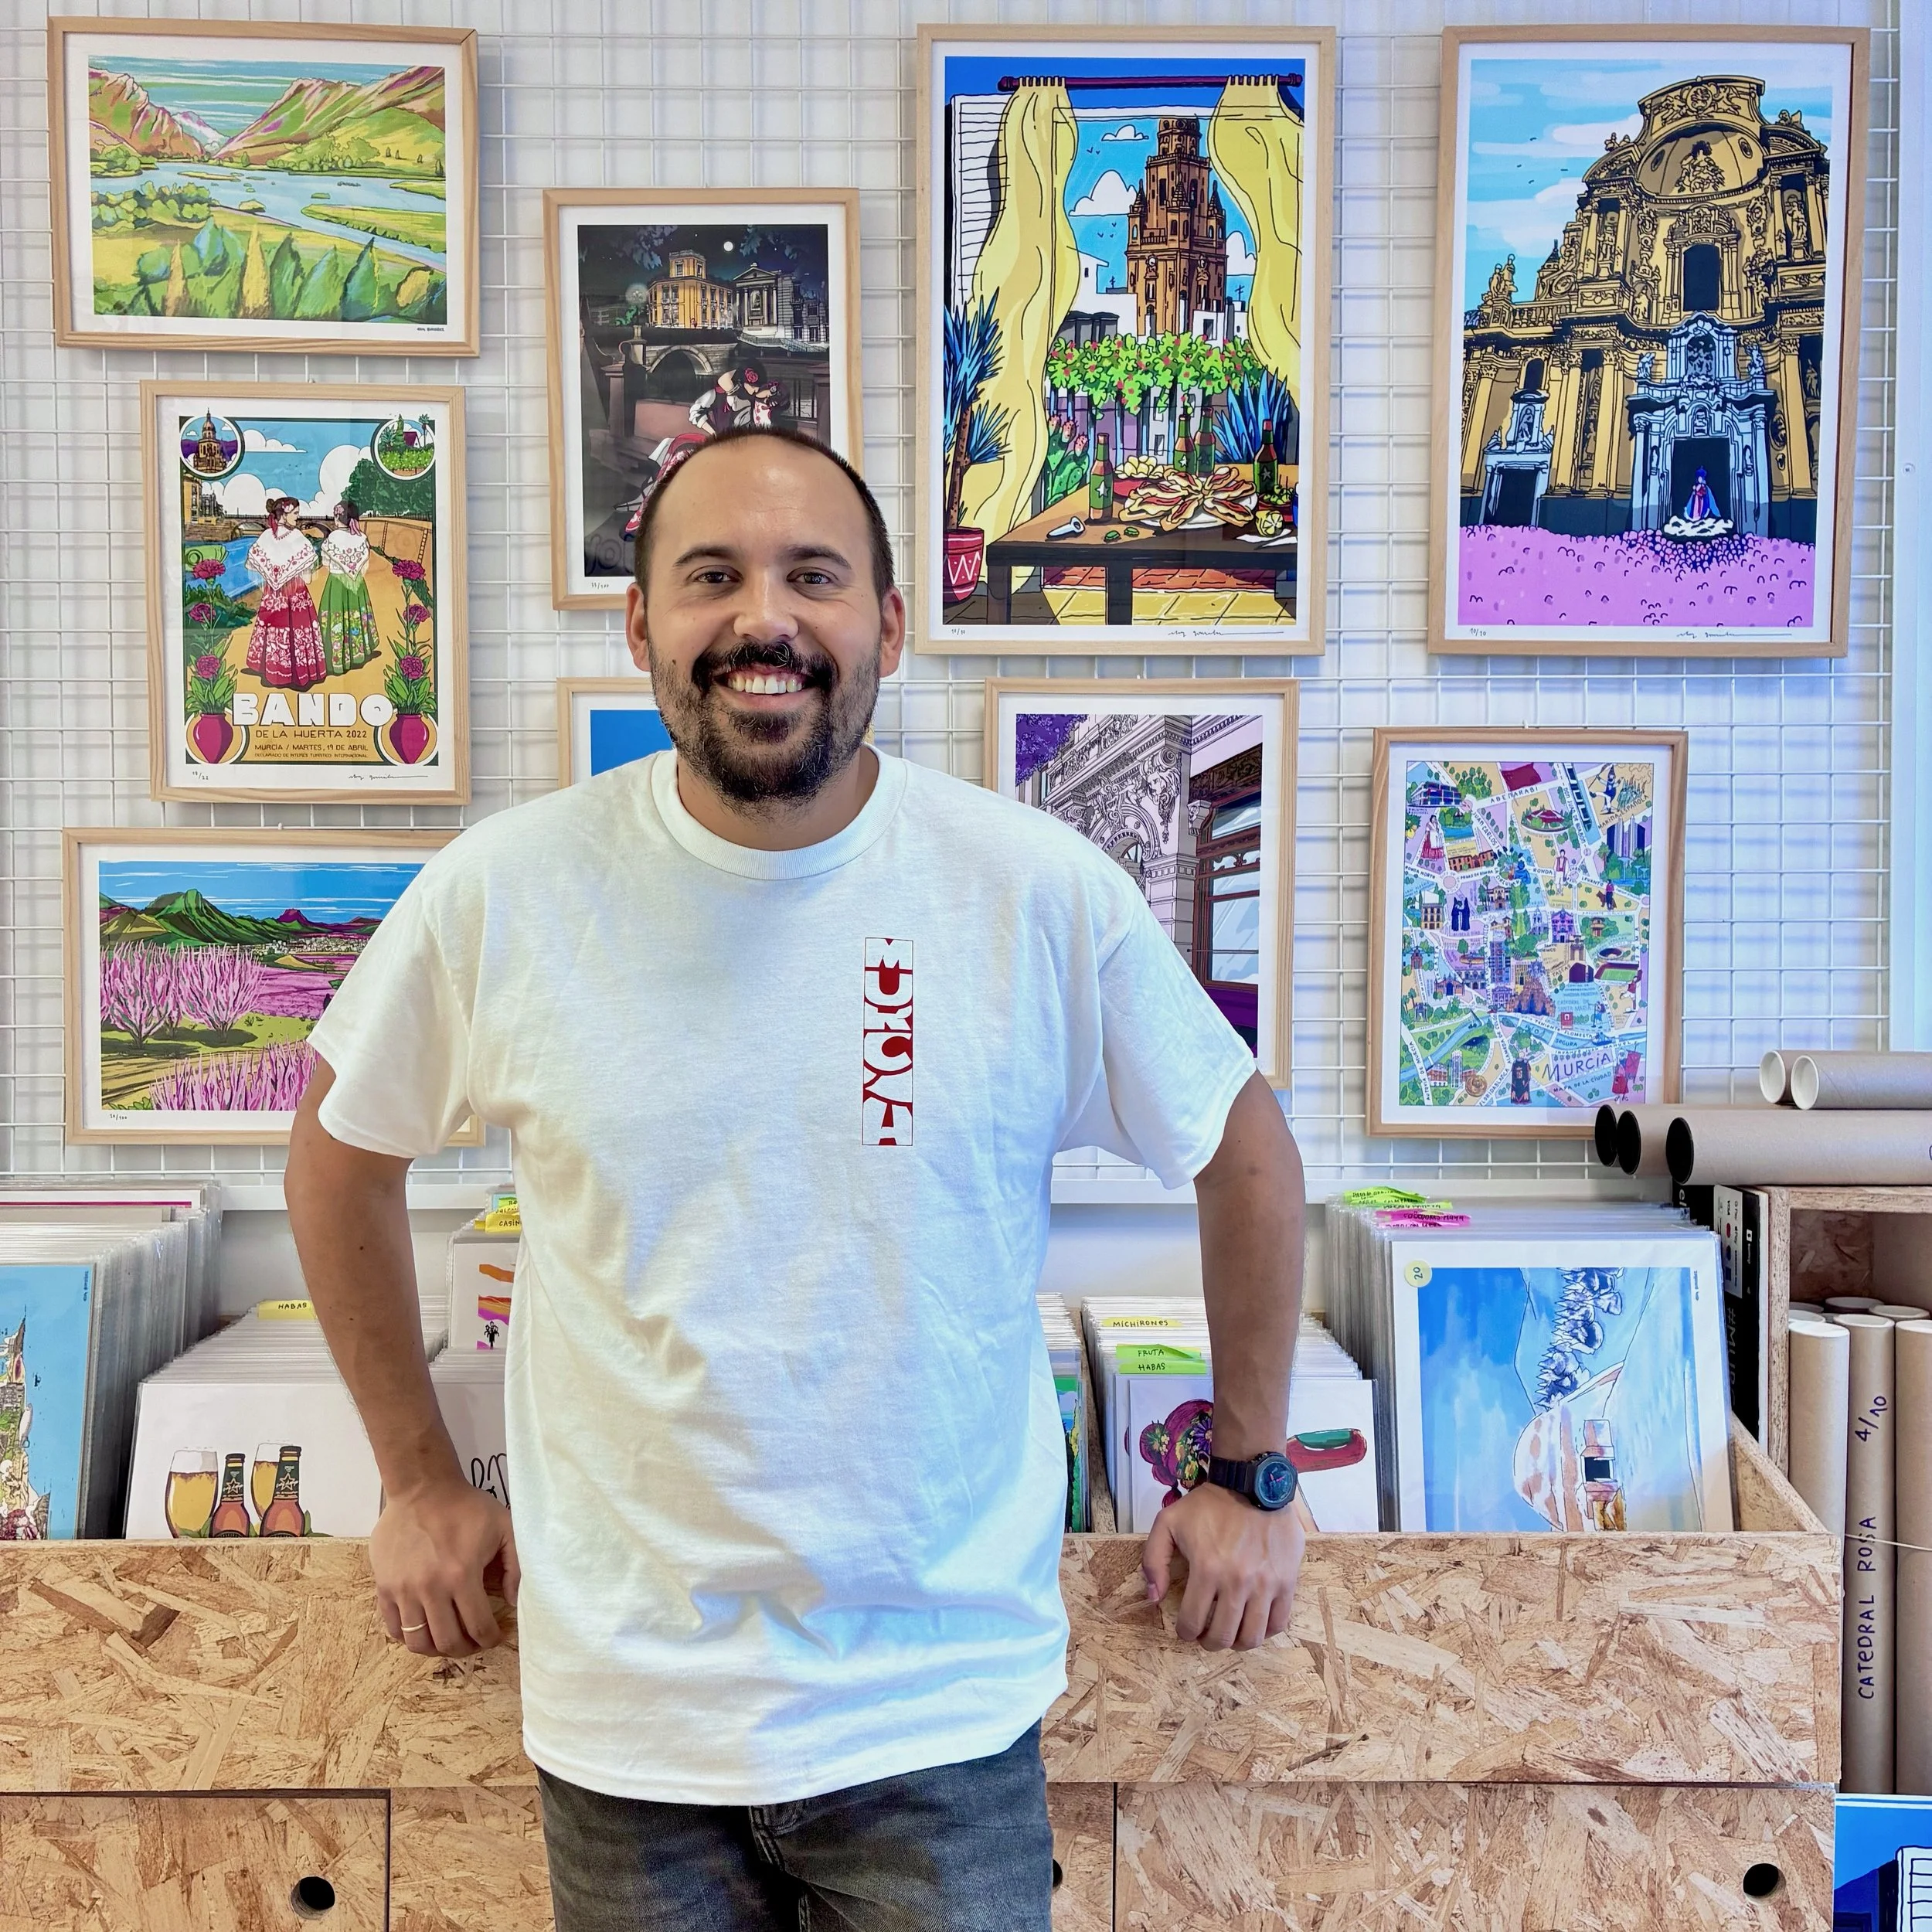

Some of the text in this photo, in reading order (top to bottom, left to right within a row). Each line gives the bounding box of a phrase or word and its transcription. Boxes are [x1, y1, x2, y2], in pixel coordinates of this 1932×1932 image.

[232, 692, 394, 727] BANDO
[256, 730, 367, 738] DE LA HUERTA 2022
[1542, 1052, 1611, 1082] MURCIA
[1413, 1266, 1423, 1281] 20
[277, 1301, 307, 1310] HABAS
[1138, 1349, 1165, 1357] FRUTA
[1138, 1362, 1165, 1371] HABAS
[1854, 1396, 1888, 1442] 4/10
[1857, 1516, 1876, 1572] ROSA
